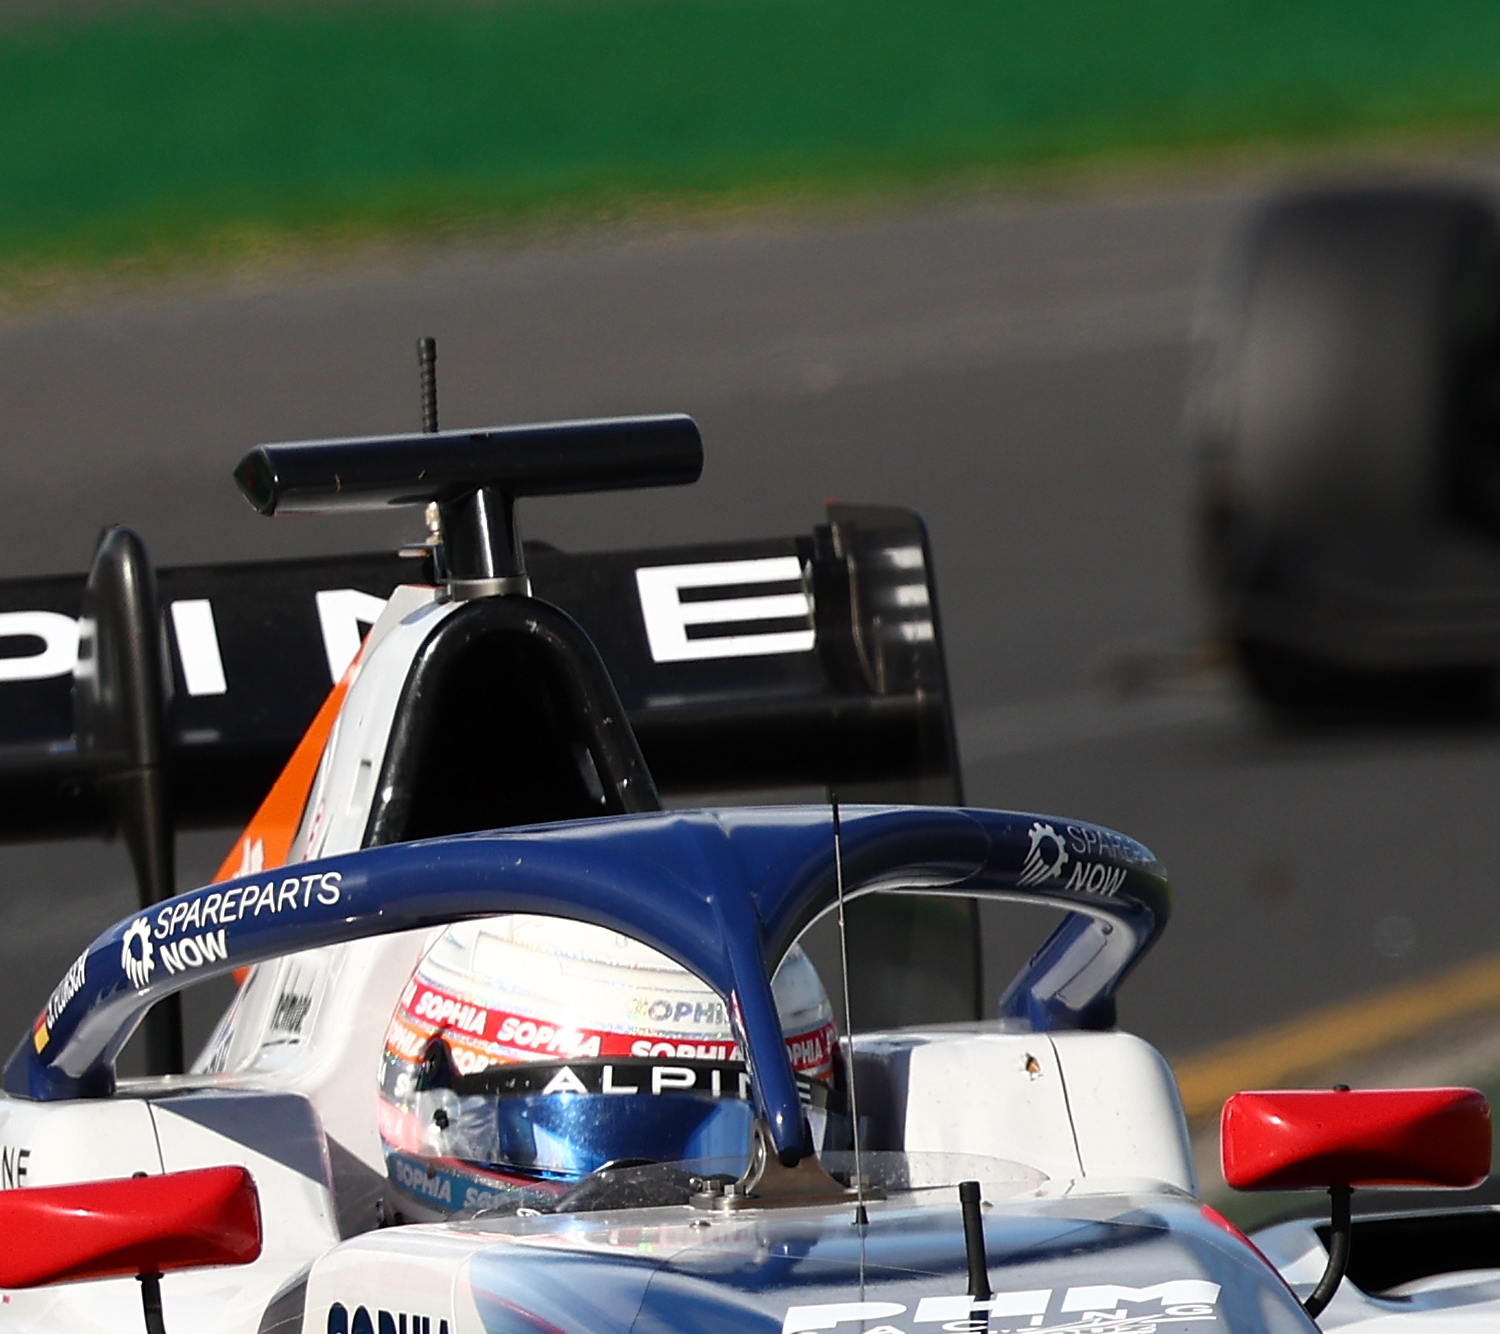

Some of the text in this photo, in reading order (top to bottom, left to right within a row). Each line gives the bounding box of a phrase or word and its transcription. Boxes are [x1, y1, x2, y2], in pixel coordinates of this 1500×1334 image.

[1065, 861, 1128, 897] NOW
[153, 871, 342, 939] SPAREPARTS
[159, 928, 228, 974] NOW
[414, 991, 488, 1035] SOPHIA
